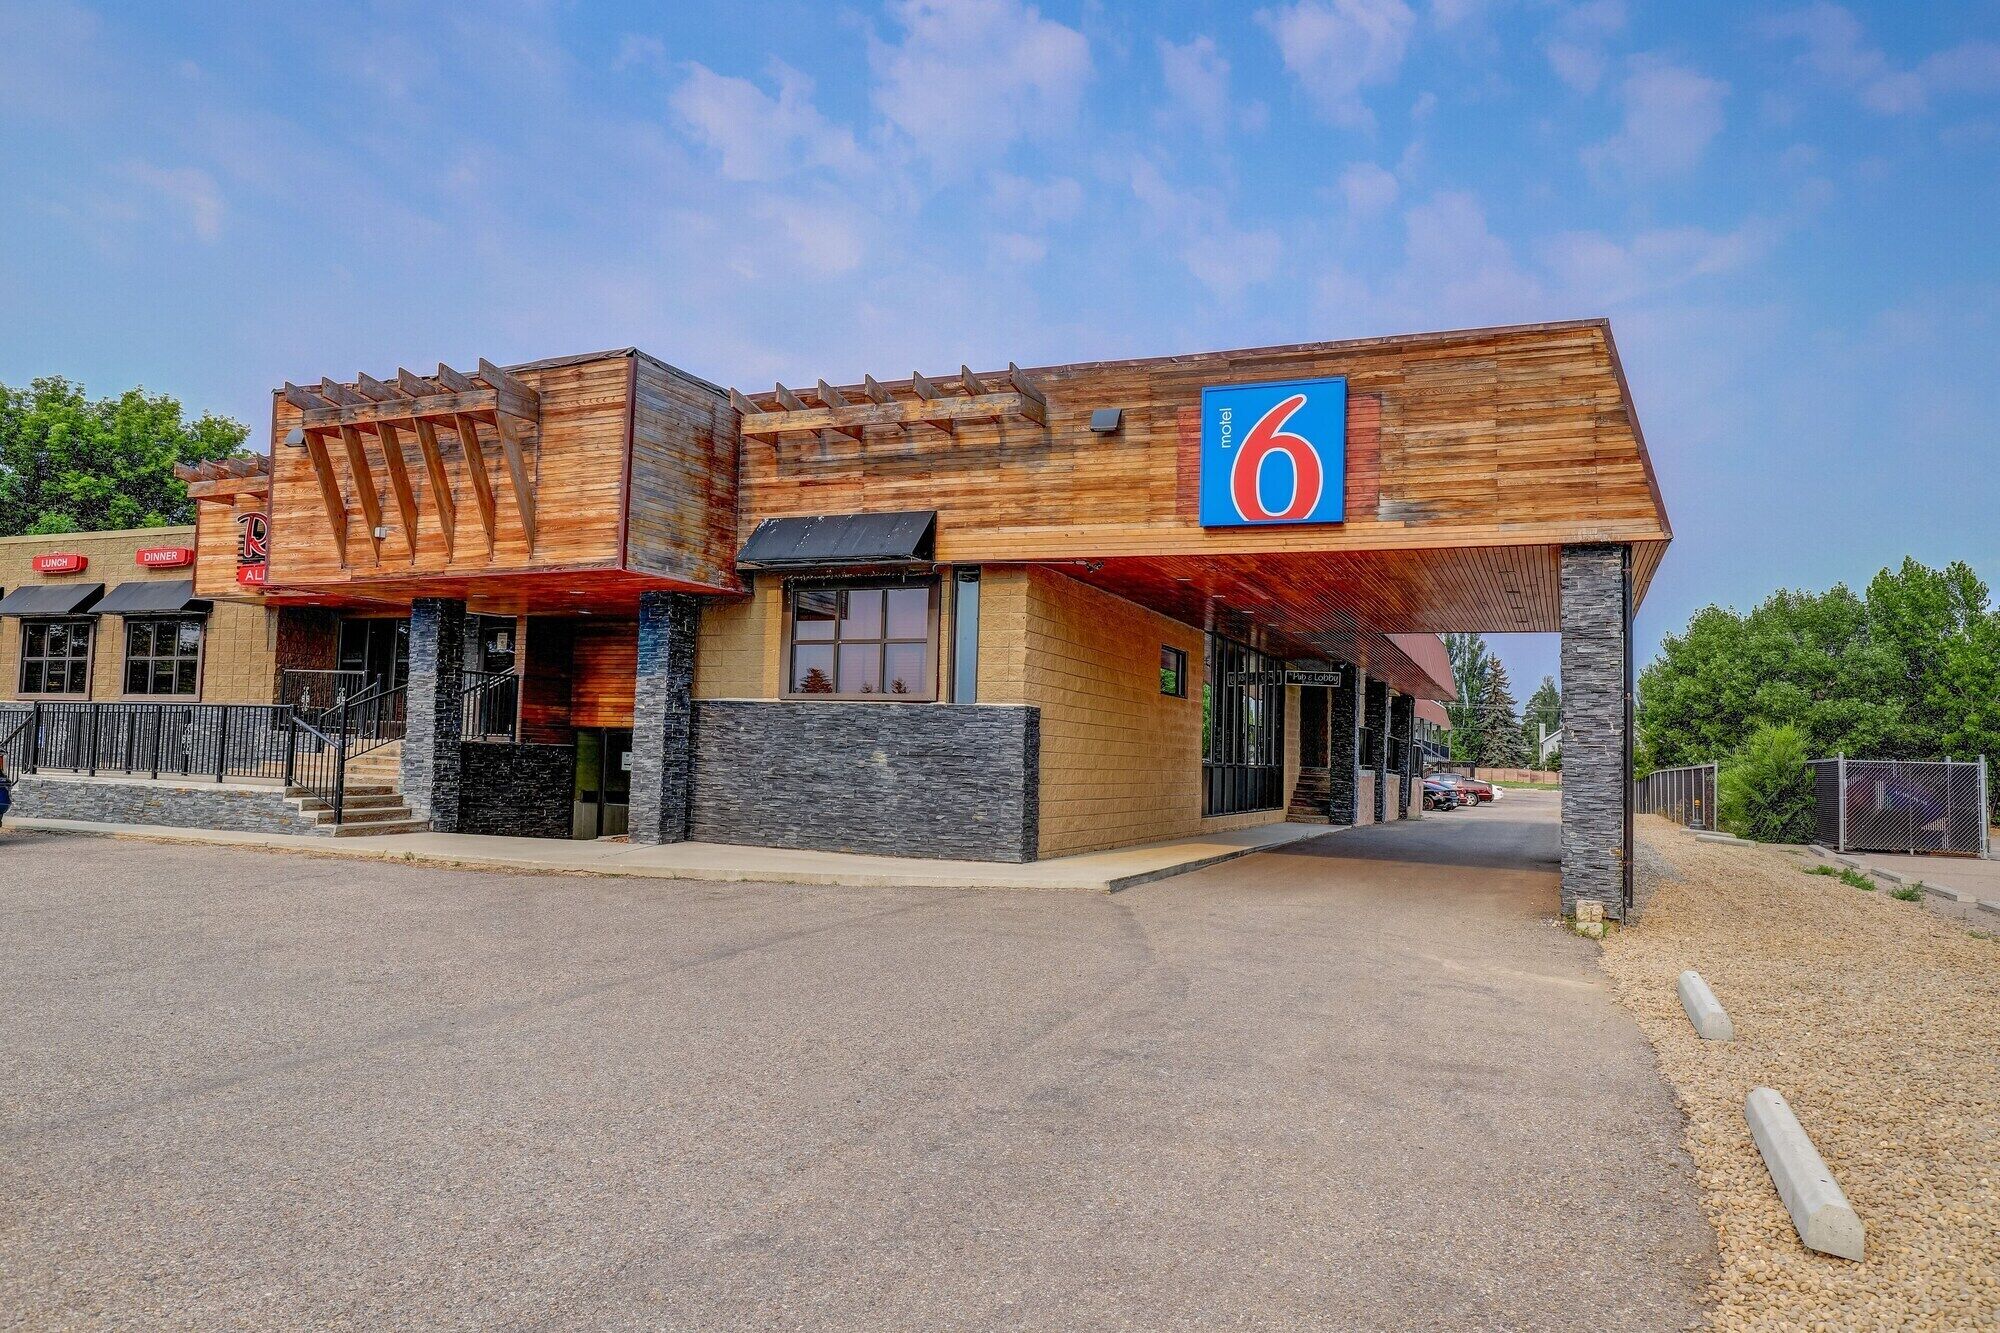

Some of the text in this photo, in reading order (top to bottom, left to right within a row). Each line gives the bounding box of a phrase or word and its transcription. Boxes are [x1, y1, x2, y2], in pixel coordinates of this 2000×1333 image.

[1219, 408, 1232, 448] motel
[1230, 394, 1323, 521] 6
[41, 558, 68, 567] LUNCH
[144, 552, 178, 561] DINNER
[1314, 673, 1338, 685] Lobby
